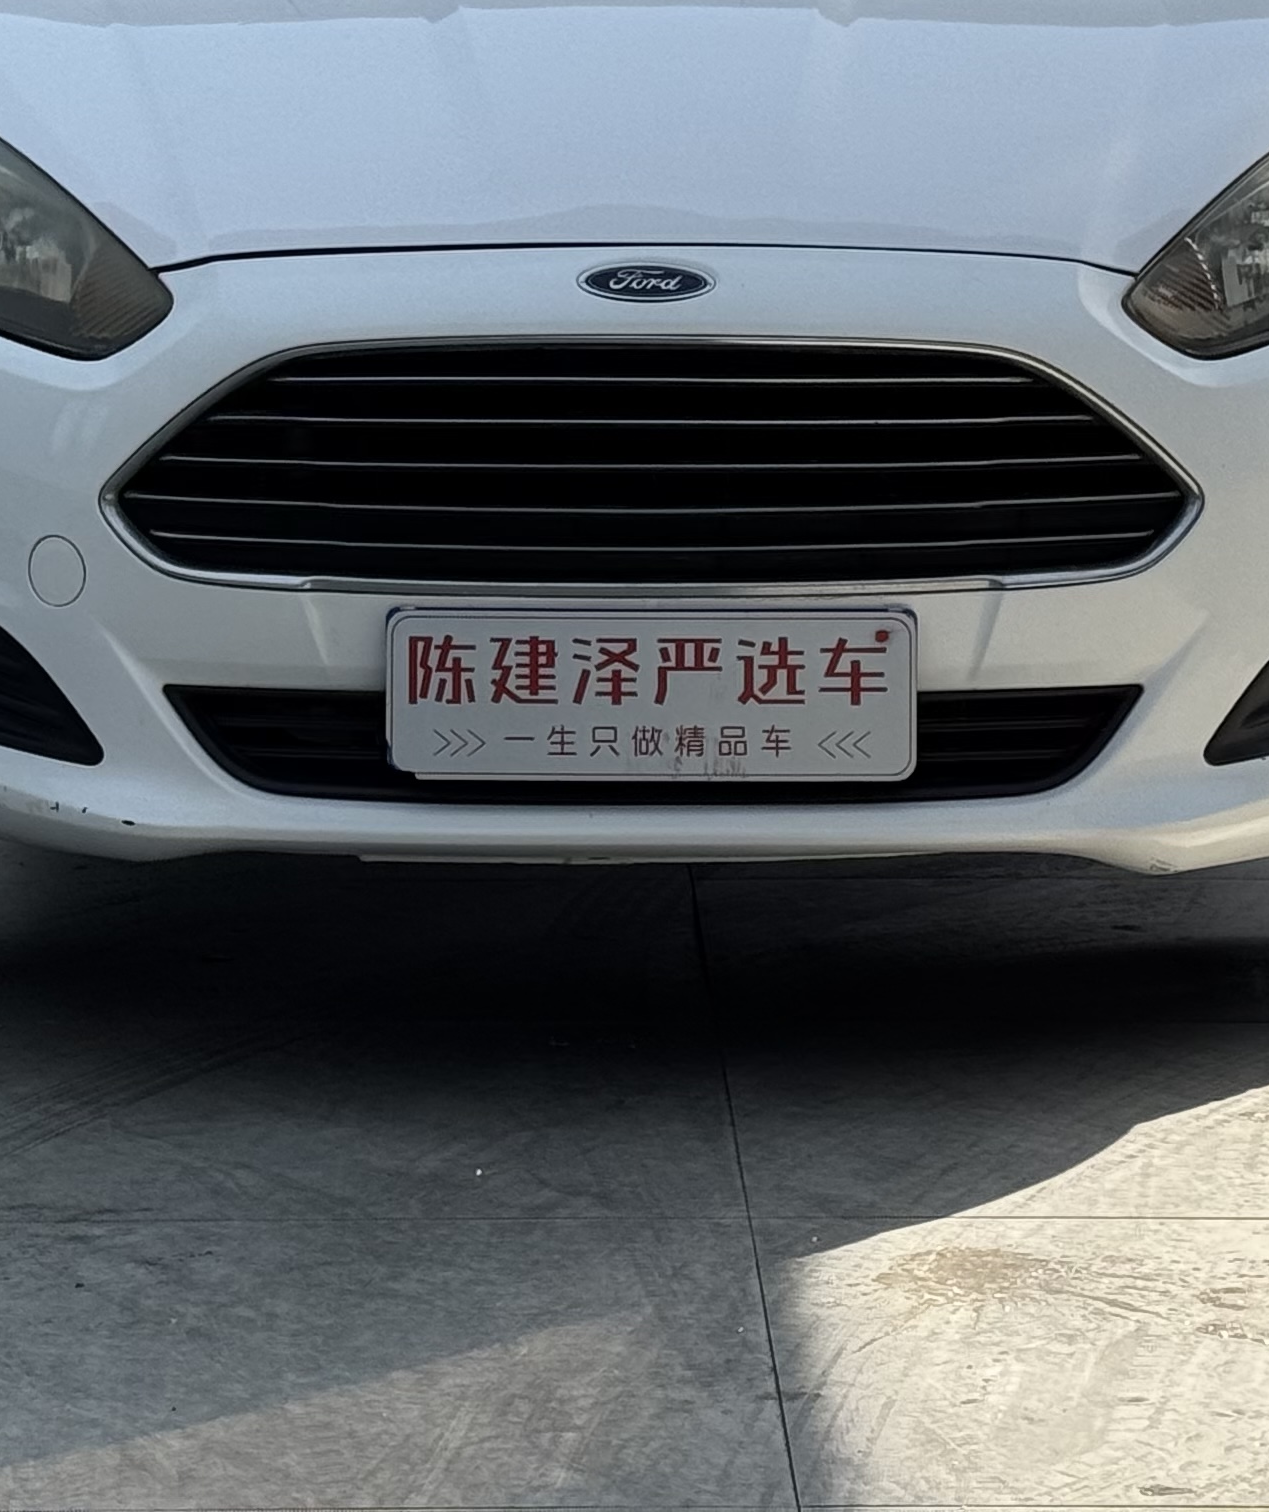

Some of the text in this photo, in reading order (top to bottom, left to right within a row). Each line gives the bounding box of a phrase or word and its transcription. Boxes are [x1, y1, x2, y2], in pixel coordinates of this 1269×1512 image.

[609, 269, 682, 290] Ford
[406, 634, 888, 706] 陈建泽严选车
[503, 724, 793, 758] 一生只做精品车
